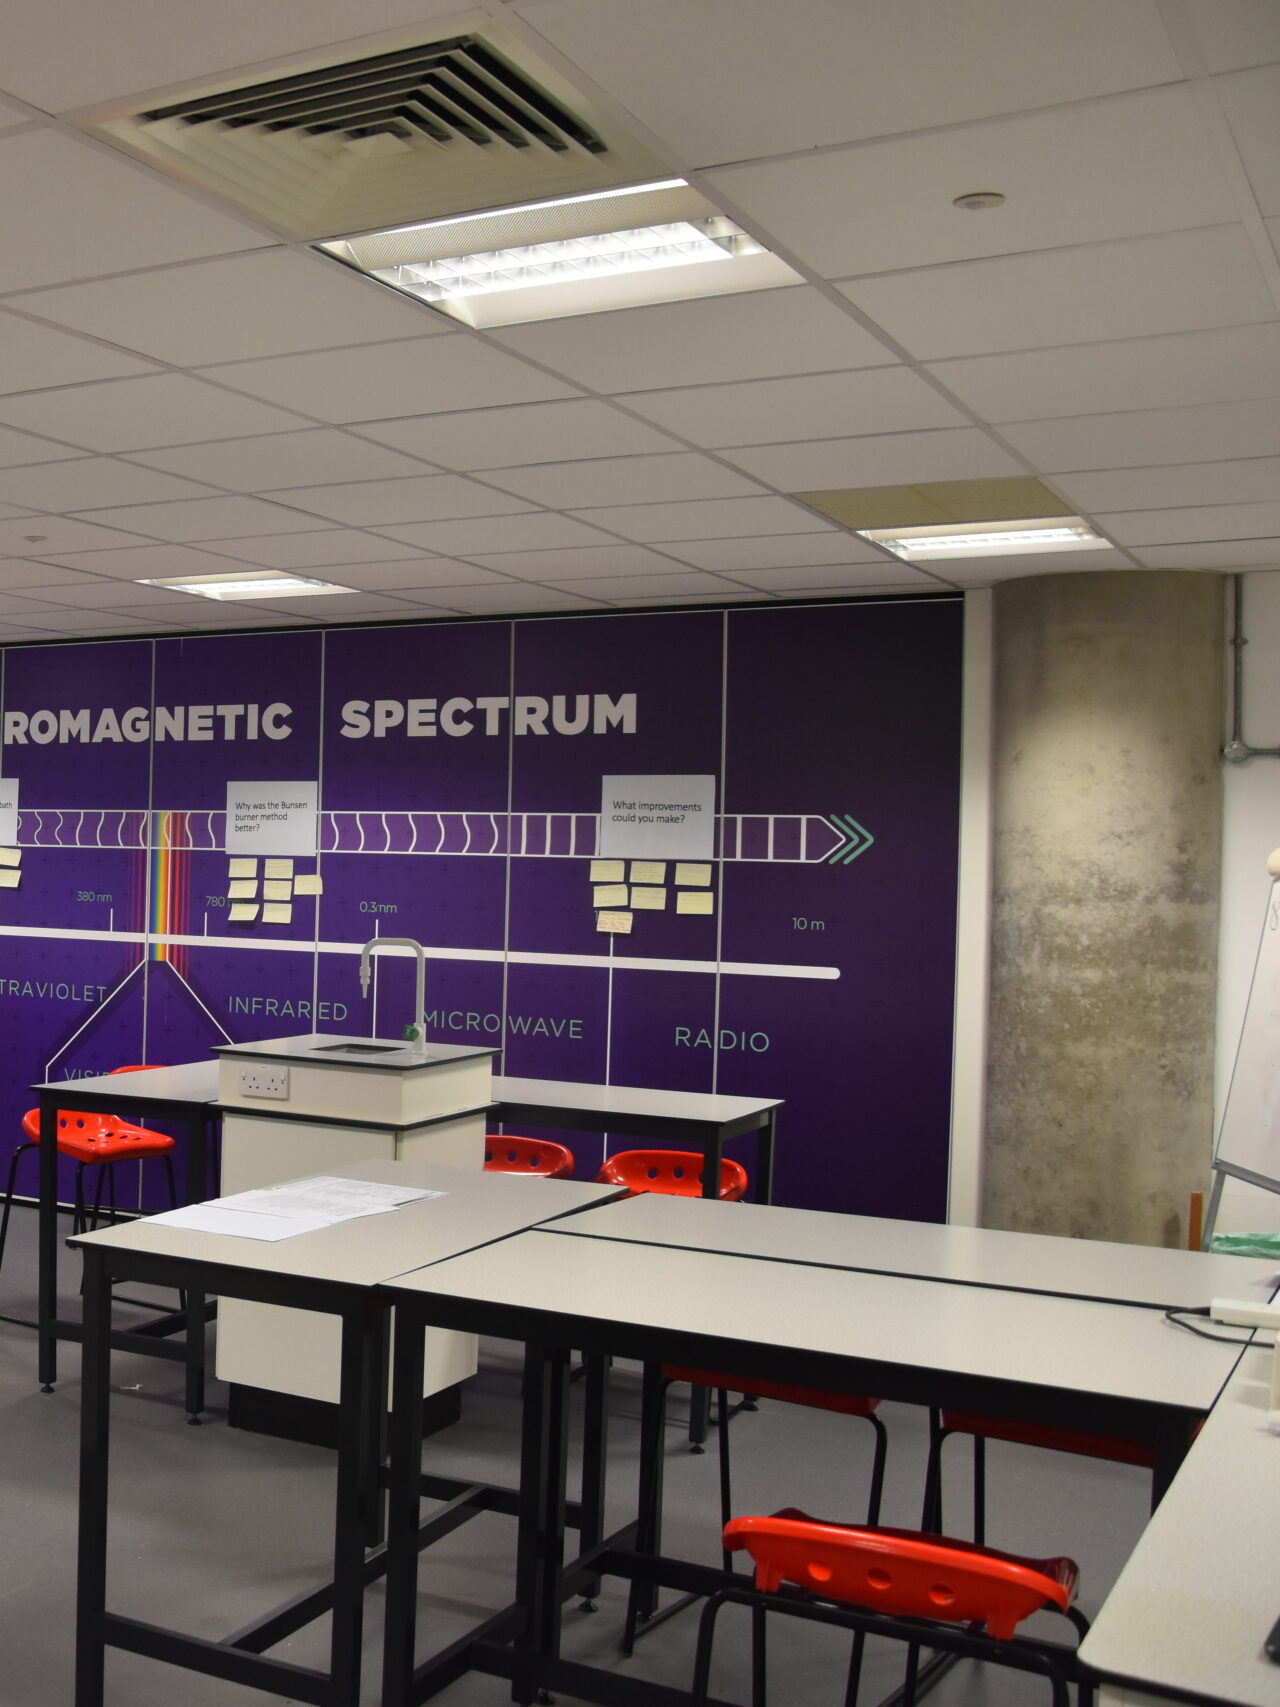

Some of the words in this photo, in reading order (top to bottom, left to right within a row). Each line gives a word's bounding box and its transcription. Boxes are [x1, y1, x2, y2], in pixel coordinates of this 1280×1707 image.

[340, 693, 637, 738] SPECTRUM
[235, 801, 251, 811] Why
[267, 801, 280, 810] the
[281, 801, 307, 809] Bunsen
[613, 800, 636, 810] What
[638, 801, 702, 812] improvements
[235, 812, 258, 821] burner
[260, 812, 288, 821] method
[612, 813, 636, 822] could
[638, 815, 654, 824] you
[656, 814, 686, 824] make?
[235, 823, 260, 832] better?
[76, 890, 95, 902] 380
[96, 893, 112, 902] nm
[205, 896, 226, 907] 780
[792, 917, 807, 930] 10
[811, 920, 825, 930] m
[228, 996, 348, 1021] INFRARED
[675, 1026, 770, 1052] RADIO
